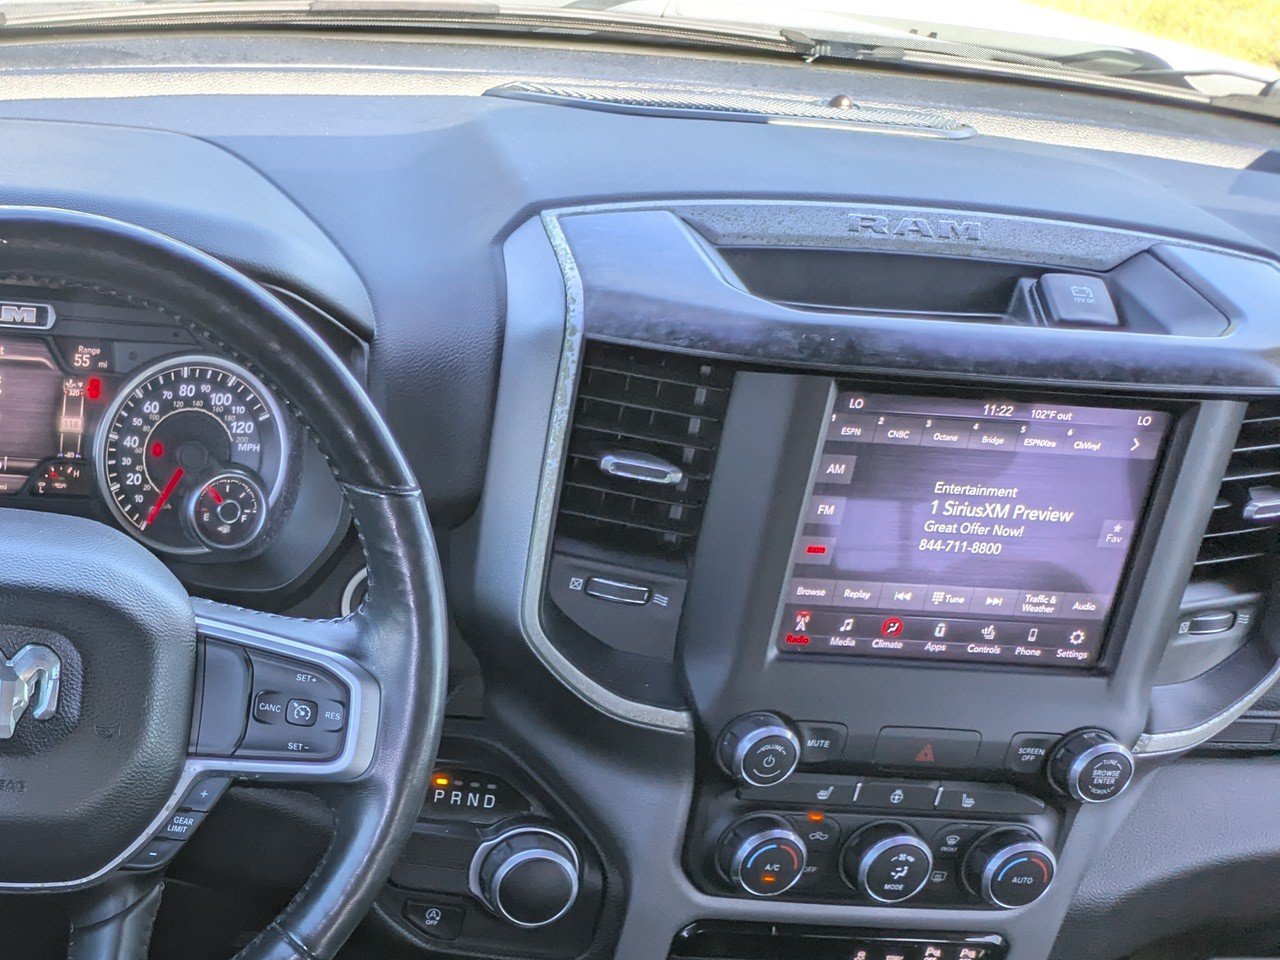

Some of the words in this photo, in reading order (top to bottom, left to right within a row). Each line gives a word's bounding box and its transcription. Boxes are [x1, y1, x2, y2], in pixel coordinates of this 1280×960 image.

[848, 213, 982, 241] RAM
[78, 345, 101, 355] Range
[73, 354, 90, 367] 55
[98, 361, 108, 369] mi
[178, 384, 195, 397] 80
[200, 385, 211, 393] 90
[162, 390, 173, 399] 70
[209, 393, 232, 406] 100
[143, 401, 160, 413] 60
[848, 397, 864, 409] LO
[231, 405, 246, 414] 110
[983, 404, 1014, 417] 11:22
[831, 413, 837, 422] 1
[1031, 409, 1057, 419] 102°F
[1057, 411, 1073, 421] out
[64, 420, 80, 429] 118
[132, 417, 143, 426] 50
[877, 417, 885, 425] 2
[925, 419, 932, 428] 3
[1137, 416, 1152, 426] LO
[230, 421, 254, 434] 120
[840, 426, 862, 436] ESPN
[972, 422, 979, 431] 4
[1020, 425, 1027, 433] 5
[887, 429, 910, 439] CNBC
[933, 432, 959, 442] Octane
[1067, 428, 1074, 436] 6
[123, 436, 139, 448] 40
[981, 435, 1005, 446] Bridge
[237, 443, 260, 452] MPH
[121, 457, 132, 466] 30
[73, 469, 80, 478] H
[826, 463, 846, 475] AM
[126, 473, 142, 485] 20
[933, 481, 1018, 498] Entertainment
[134, 494, 144, 503] 10
[817, 504, 835, 516] FM
[931, 500, 938, 514] 1
[942, 501, 1010, 519] SiriusXM
[1013, 504, 1074, 523] Preview
[203, 513, 210, 521] E
[241, 515, 247, 523] F
[923, 520, 958, 534] Great
[959, 522, 991, 536] Offer
[992, 524, 1025, 537] Now!
[1105, 533, 1123, 544] Fav
[918, 539, 1002, 555] 844-711-8800
[796, 586, 826, 597] Browse
[843, 589, 871, 601] Replay
[945, 594, 965, 604] Tune
[1024, 593, 1048, 604] Traffic
[1049, 595, 1057, 604] &
[1022, 603, 1055, 614] Weather
[1071, 601, 1096, 611] Audio
[786, 633, 811, 644] Radio
[829, 636, 856, 647] Media
[871, 638, 903, 650] Climate
[924, 641, 946, 652] Apps
[966, 644, 1001, 655] Controls
[1014, 646, 1041, 657] Phone
[1056, 648, 1088, 660] Settings
[259, 702, 282, 713] CANC
[325, 711, 341, 721] RES
[760, 743, 784, 753] VOLUME
[807, 740, 830, 748] MUTE
[1017, 747, 1046, 756] SCREEN
[1092, 769, 1121, 777] BROWSE
[433, 789, 445, 803] P
[450, 791, 462, 805] R
[466, 792, 480, 807] N
[483, 794, 496, 808] D
[173, 816, 194, 826] GEAR
[167, 824, 188, 834] LIMIT
[764, 863, 781, 871] A/C
[1011, 876, 1034, 885] AUTO
[883, 883, 904, 891] MODE
